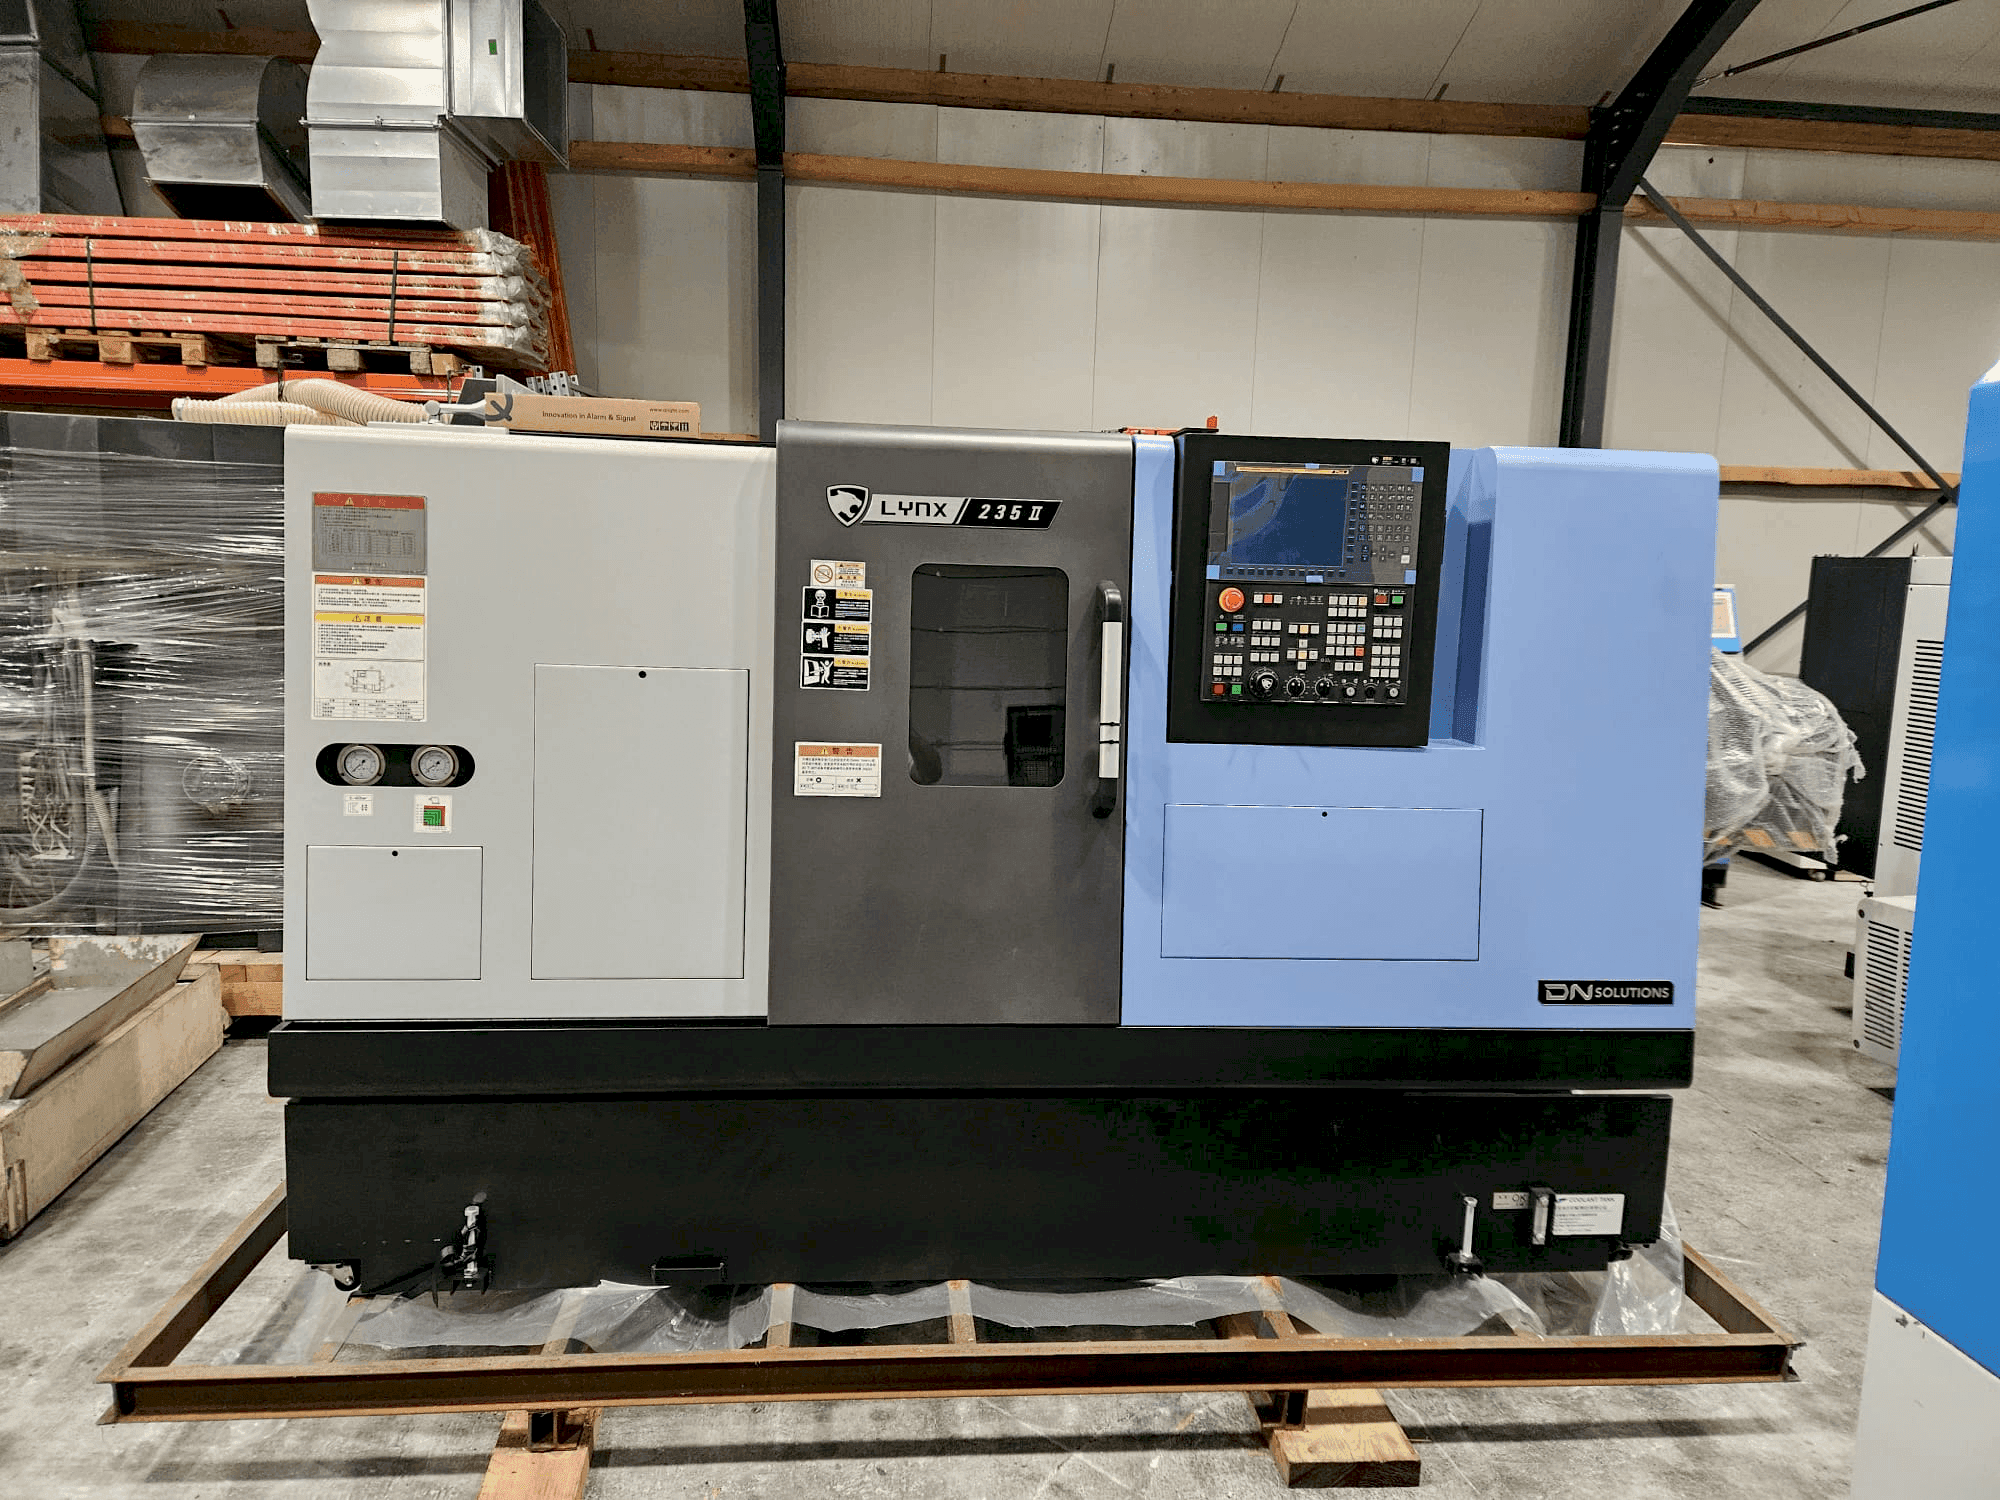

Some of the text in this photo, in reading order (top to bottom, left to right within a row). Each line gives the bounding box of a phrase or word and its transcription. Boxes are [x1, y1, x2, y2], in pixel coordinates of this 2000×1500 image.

[542, 410, 637, 423] Innovation in Alarm & Signal
[880, 499, 948, 518] LYNX
[977, 503, 1023, 521] 235
[1544, 983, 1670, 1001] DN SOLUTIONS
